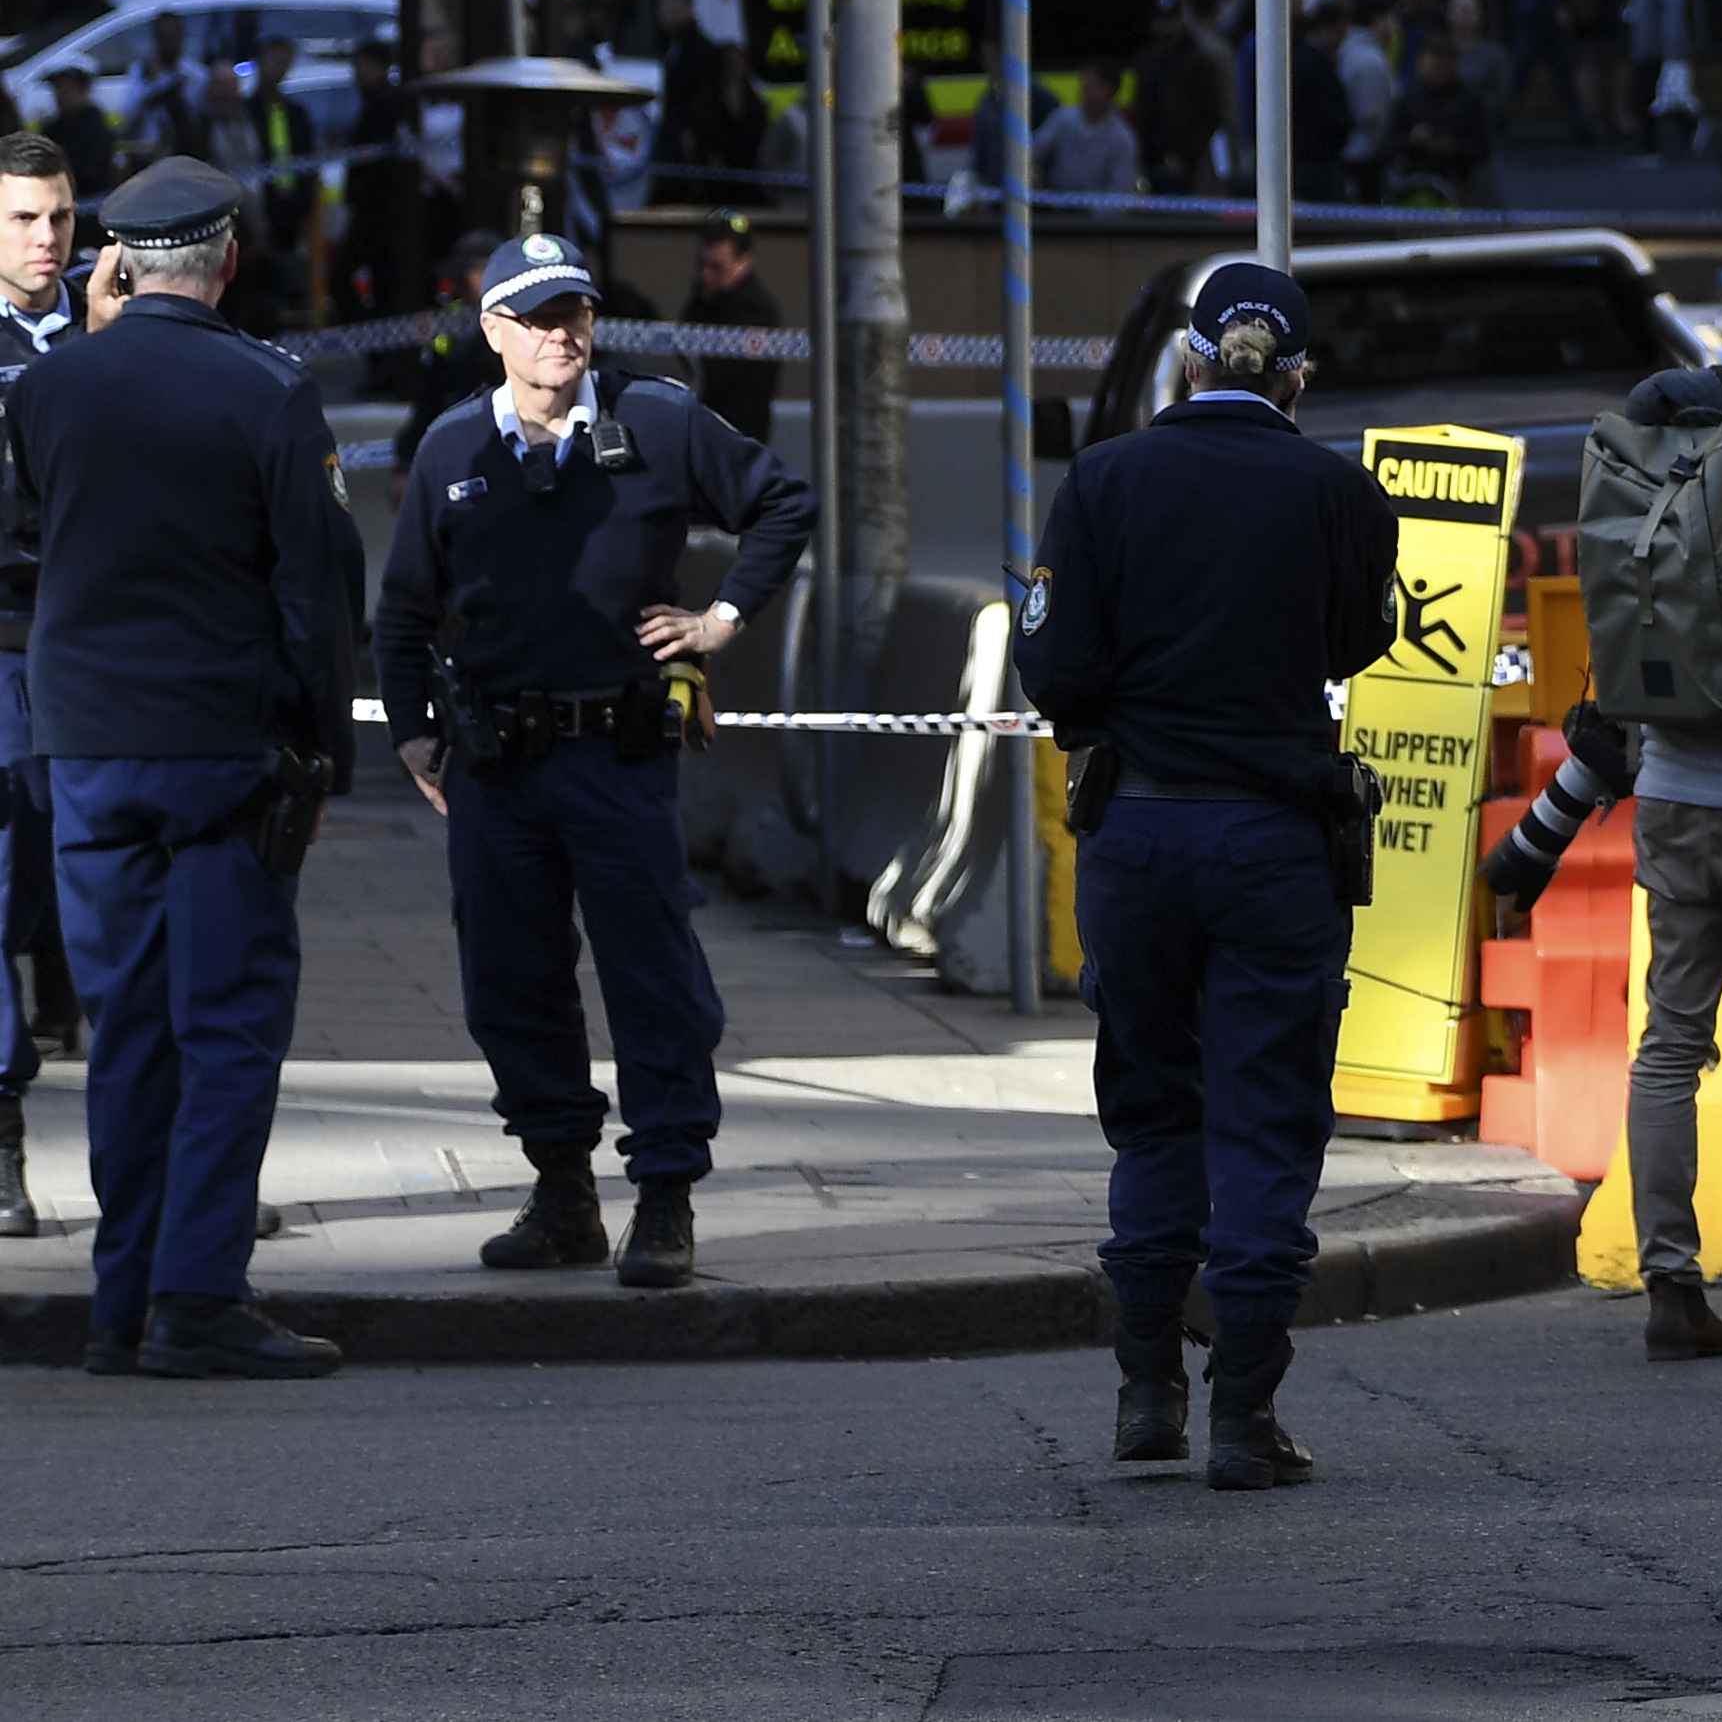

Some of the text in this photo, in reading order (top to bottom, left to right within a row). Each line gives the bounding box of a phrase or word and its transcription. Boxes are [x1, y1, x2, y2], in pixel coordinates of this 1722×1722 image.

[1217, 301, 1292, 335] NSW POLICE FORCE
[1377, 456, 1501, 506] CAUTION
[1353, 727, 1474, 768] SLIPPERY
[1378, 818, 1433, 853] WET
